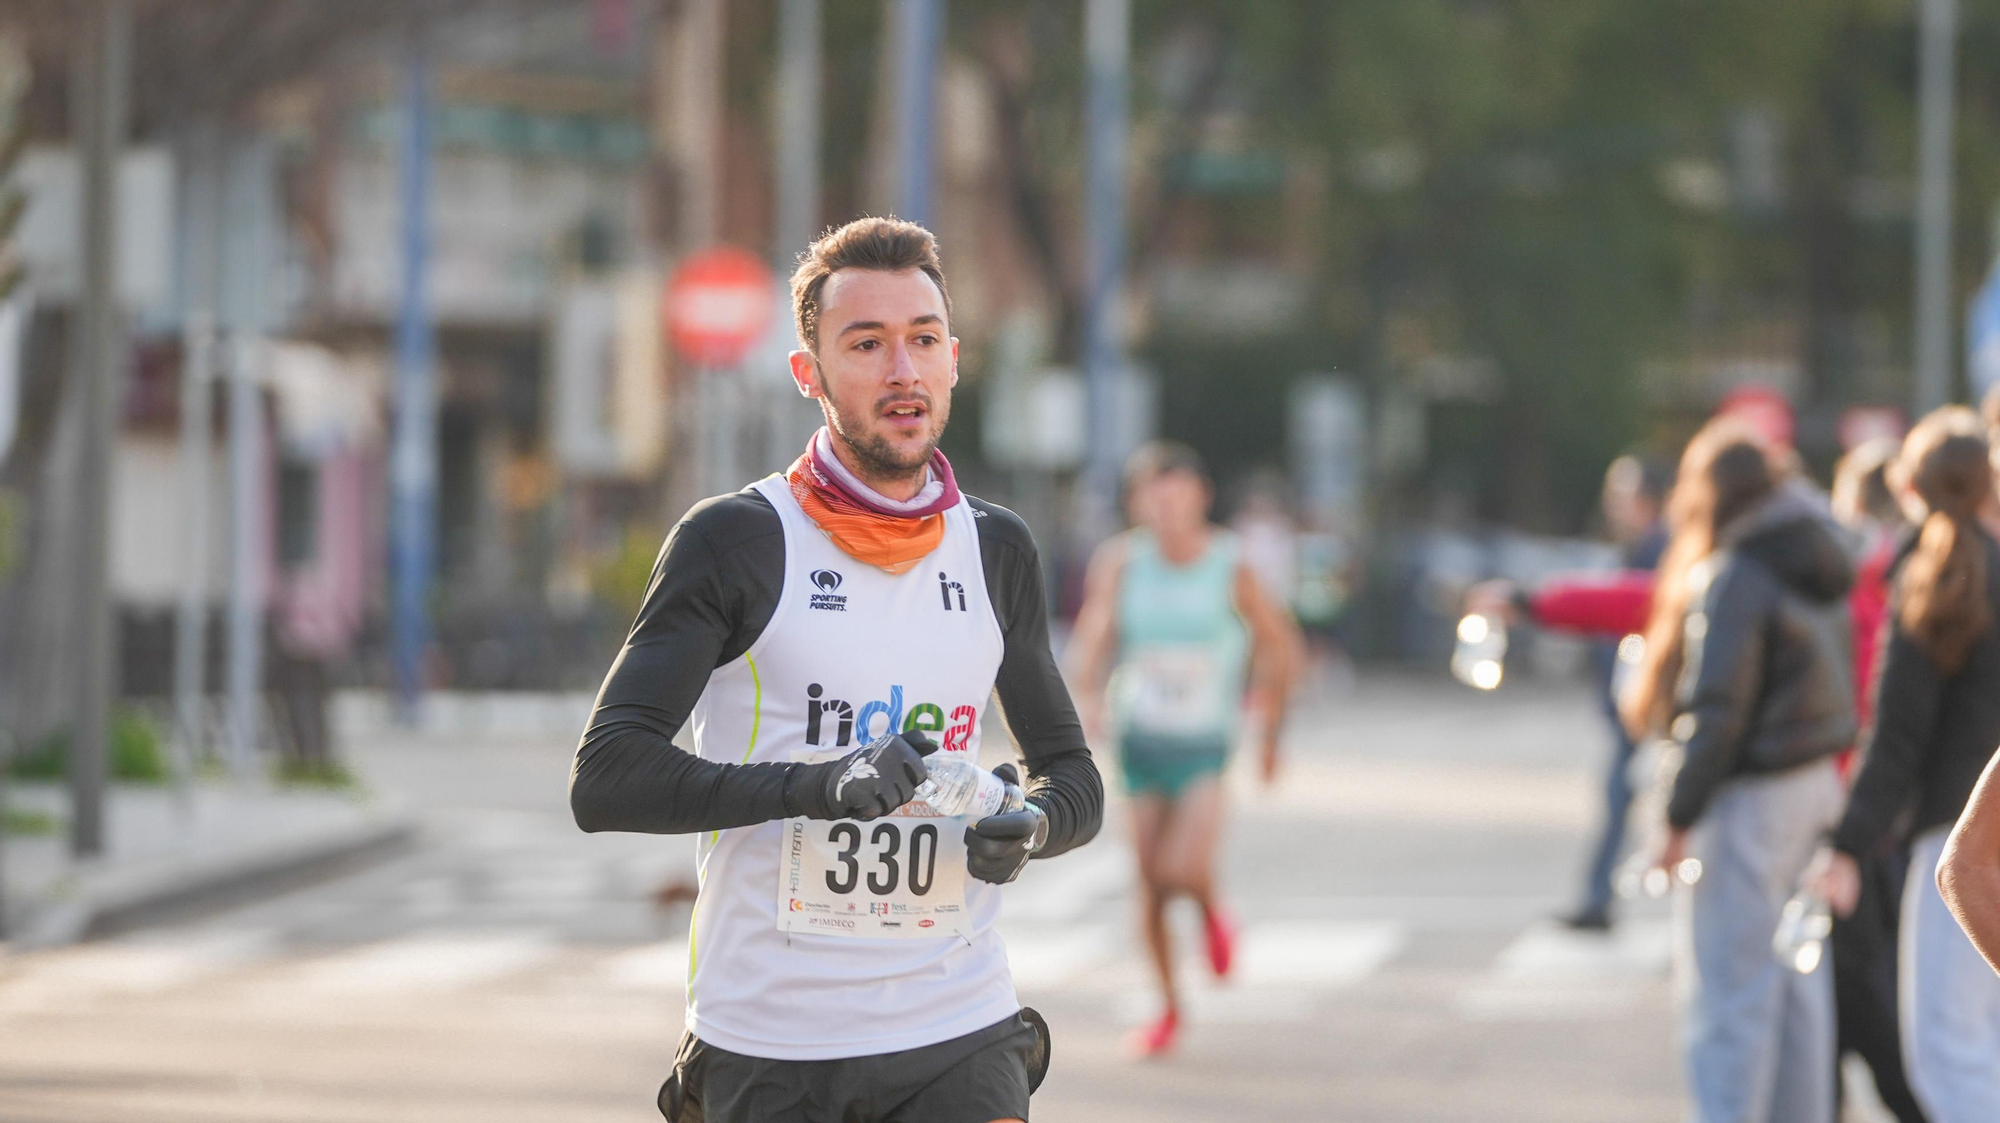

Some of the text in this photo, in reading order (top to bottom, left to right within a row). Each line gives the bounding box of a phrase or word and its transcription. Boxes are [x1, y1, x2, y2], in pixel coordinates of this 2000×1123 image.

[810, 594, 847, 603] SPORTING
[939, 572, 967, 611] in
[806, 683, 976, 752] indea
[825, 822, 938, 896] 330
[819, 918, 855, 929] IMDECO
